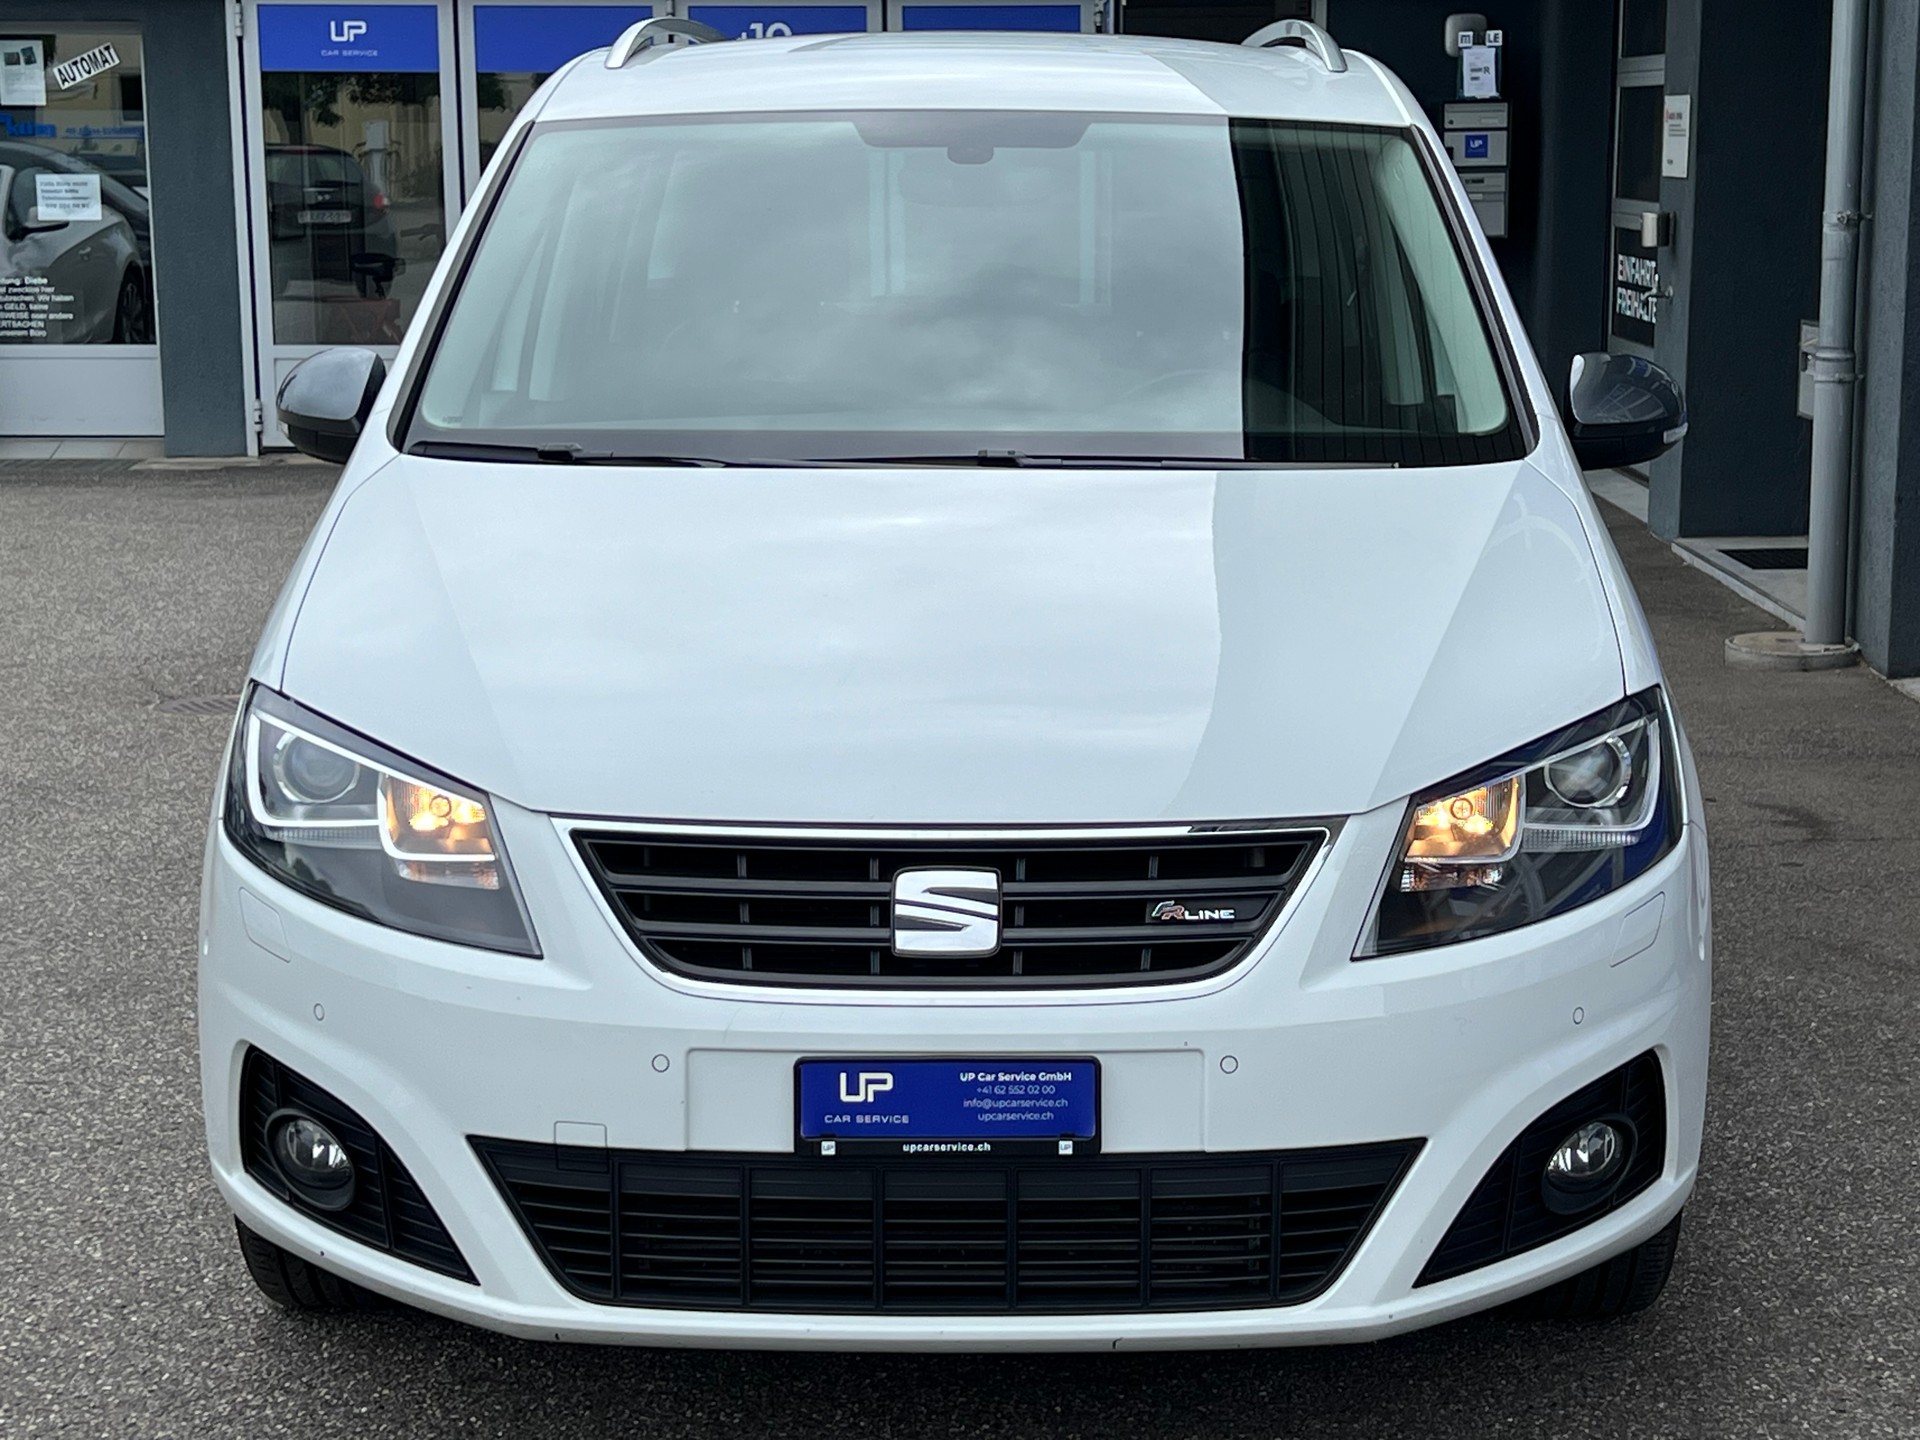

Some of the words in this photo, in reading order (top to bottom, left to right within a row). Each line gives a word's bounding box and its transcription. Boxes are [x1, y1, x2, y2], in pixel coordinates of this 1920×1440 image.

[330, 20, 367, 42] UP
[56, 44, 117, 86] AUTOMAT
[1184, 909, 1235, 920] LINE
[960, 1072, 975, 1081] UP
[977, 1072, 996, 1081] Car
[998, 1071, 1036, 1081] Service
[1038, 1072, 1072, 1081] GmbH
[840, 1072, 894, 1102] UP
[977, 1085, 992, 1094] +41
[994, 1085, 1006, 1094] 62
[1008, 1085, 1025, 1094] 552
[1027, 1085, 1040, 1094] 02
[1041, 1085, 1056, 1094] 00
[963, 1098, 1069, 1110] info@upcarservice.ch
[824, 1114, 851, 1123] CAR
[856, 1114, 909, 1123] SERVICE
[978, 1111, 1054, 1122] upcarservice.ch
[902, 1142, 991, 1154] upcarservice.ch
